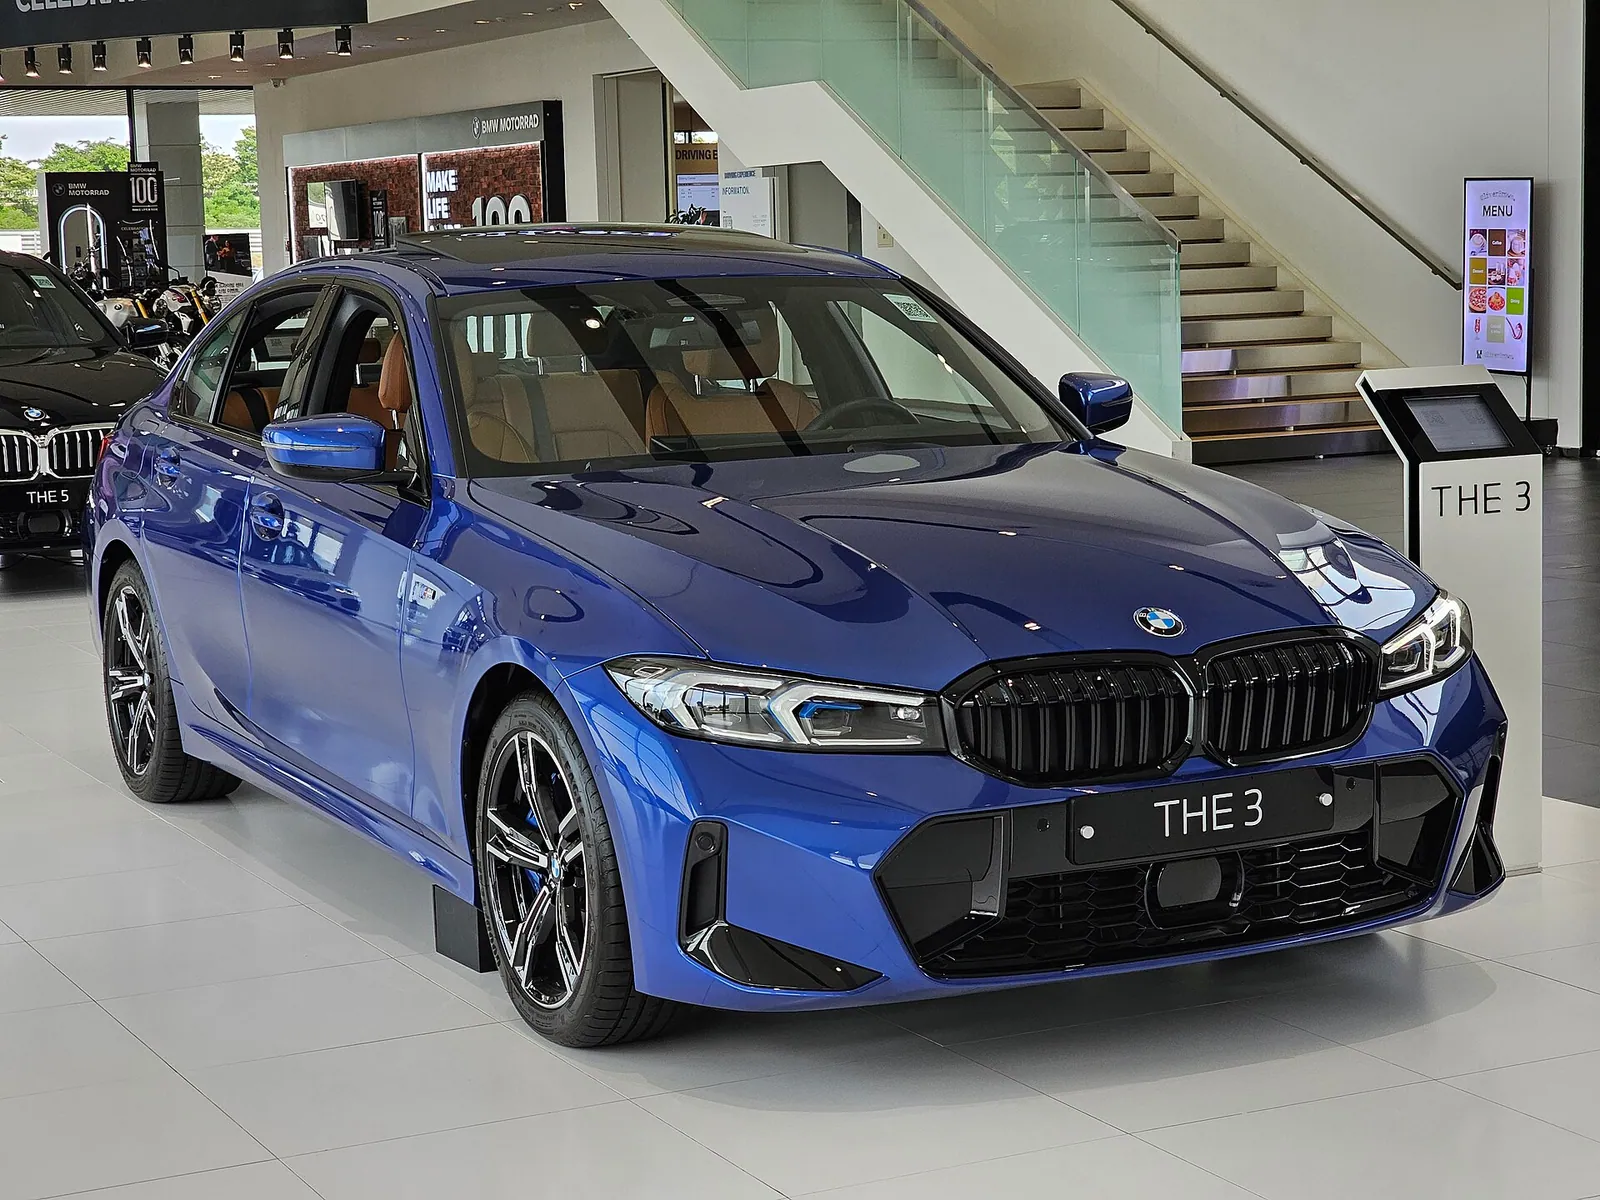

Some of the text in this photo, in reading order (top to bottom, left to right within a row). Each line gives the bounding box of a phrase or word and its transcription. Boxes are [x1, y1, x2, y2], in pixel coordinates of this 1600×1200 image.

[481, 114, 539, 134] BMW MOTORRAD
[676, 149, 711, 160] DRIVING
[129, 176, 158, 204] 100
[426, 169, 457, 192] MAKE
[427, 197, 450, 219] LIFE
[1482, 205, 1513, 217] MENU
[26, 490, 69, 504] THE 5
[1431, 481, 1531, 517] THE 3
[1153, 788, 1263, 837] THE 3
